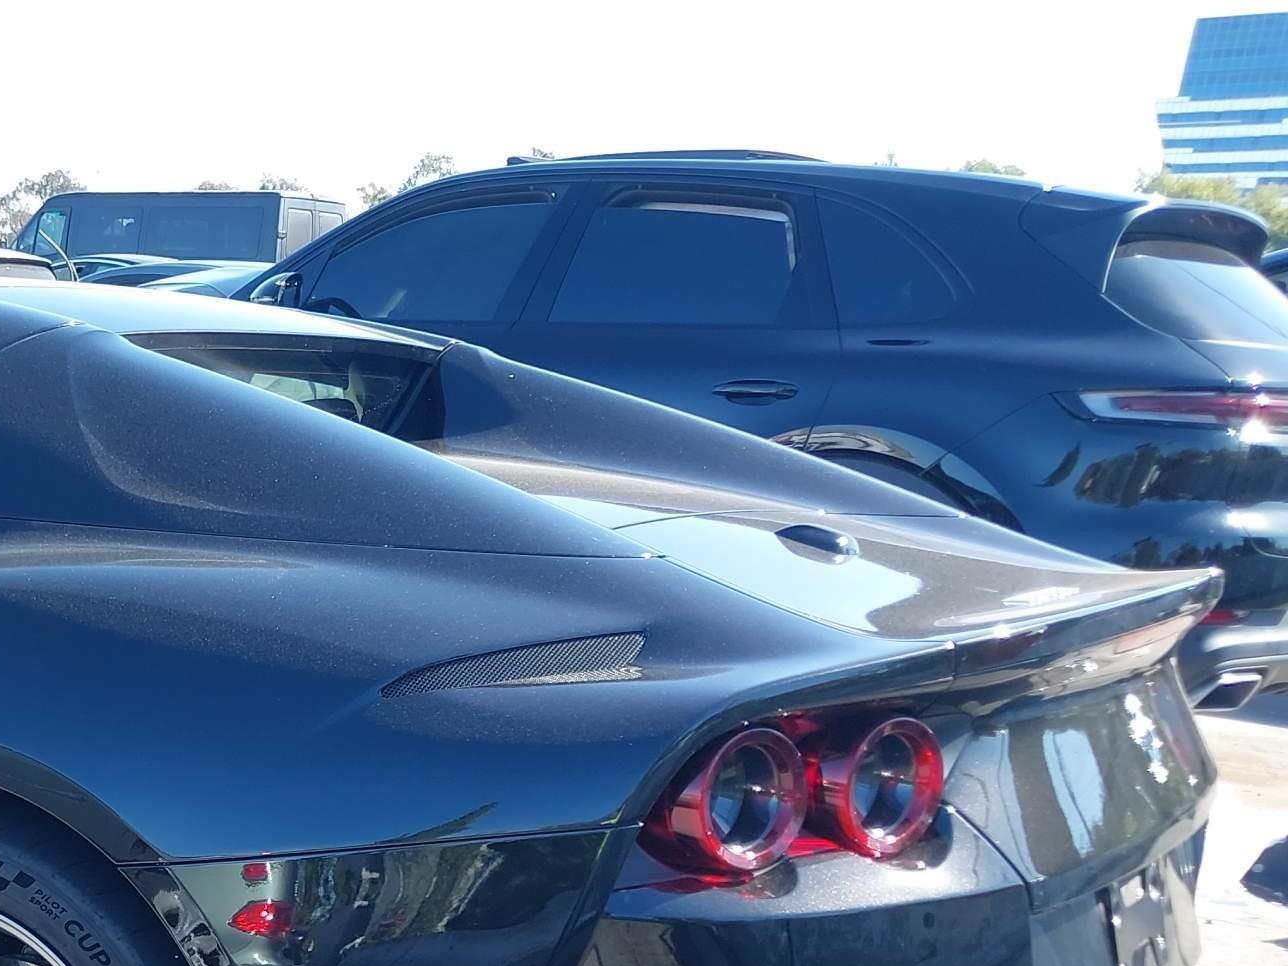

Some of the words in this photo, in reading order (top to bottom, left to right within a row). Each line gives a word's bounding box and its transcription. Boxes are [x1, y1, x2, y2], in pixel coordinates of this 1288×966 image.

[28, 894, 61, 921] SPORT
[34, 888, 68, 915] PILOT
[64, 919, 112, 966] CUP
